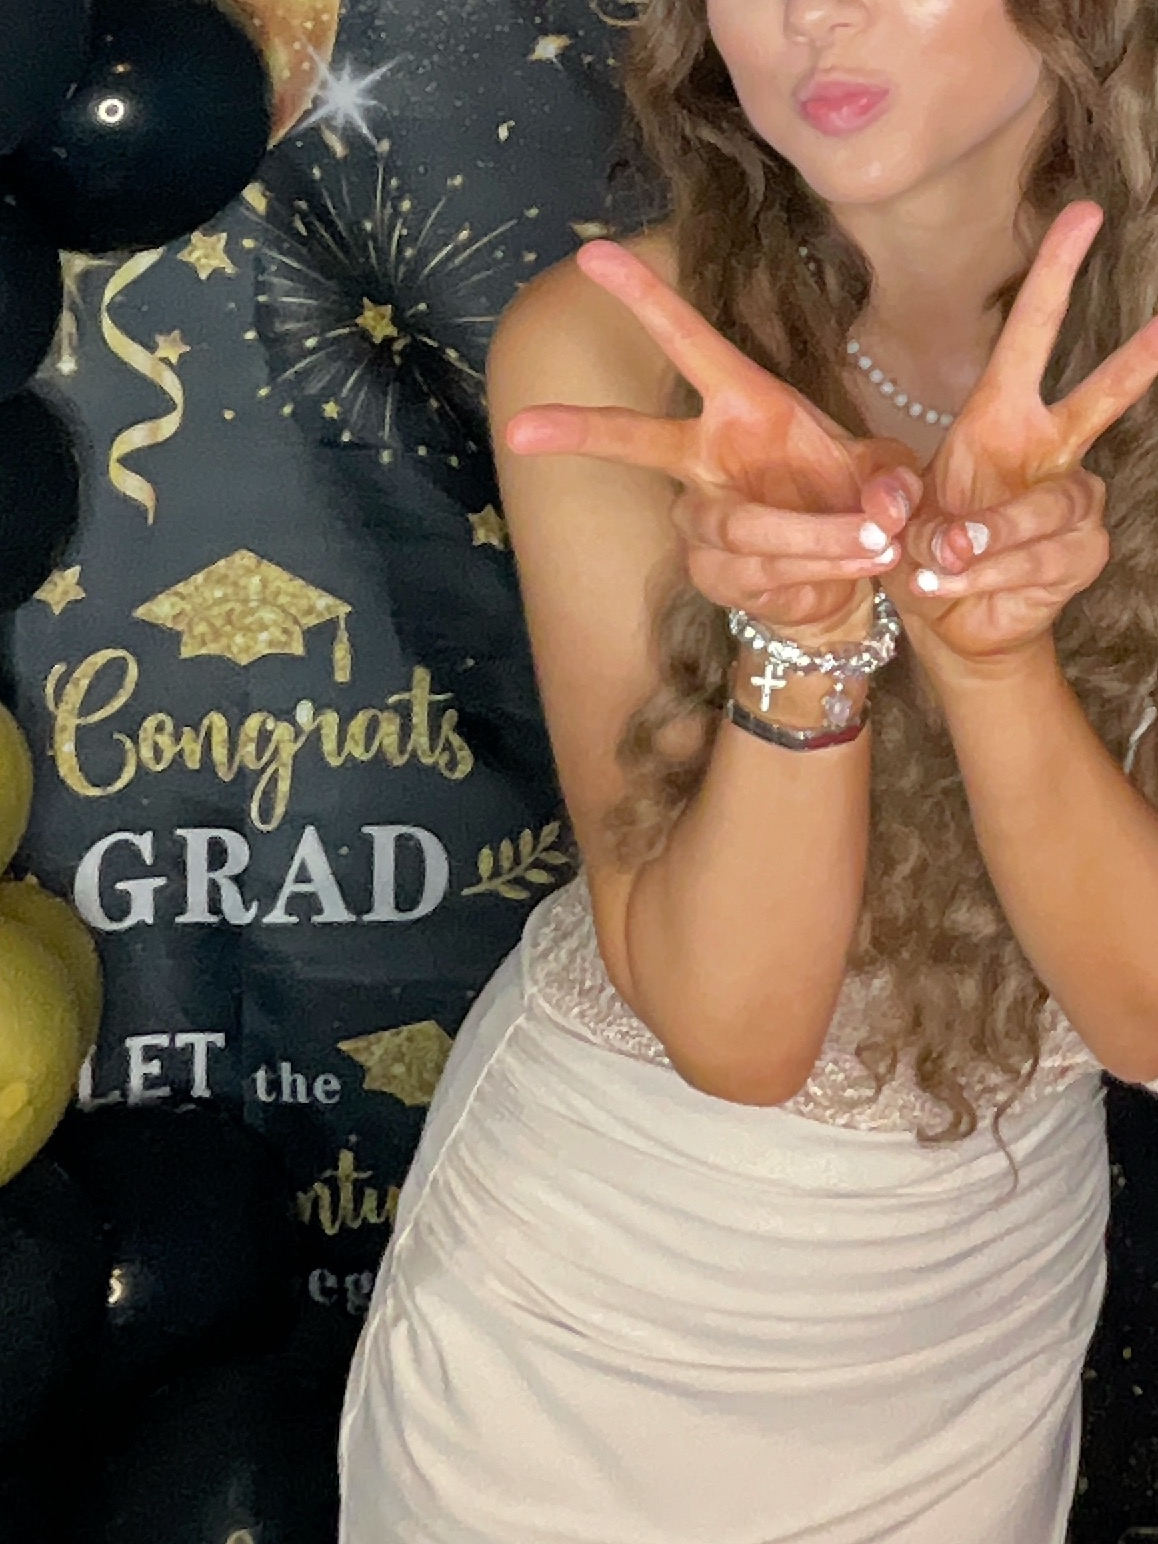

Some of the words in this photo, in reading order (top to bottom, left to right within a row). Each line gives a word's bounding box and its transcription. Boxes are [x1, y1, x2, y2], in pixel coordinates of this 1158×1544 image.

[45, 648, 474, 832] Congrats
[74, 824, 450, 931] GRAD
[76, 1032, 226, 1113] LET
[253, 1062, 343, 1104] the
